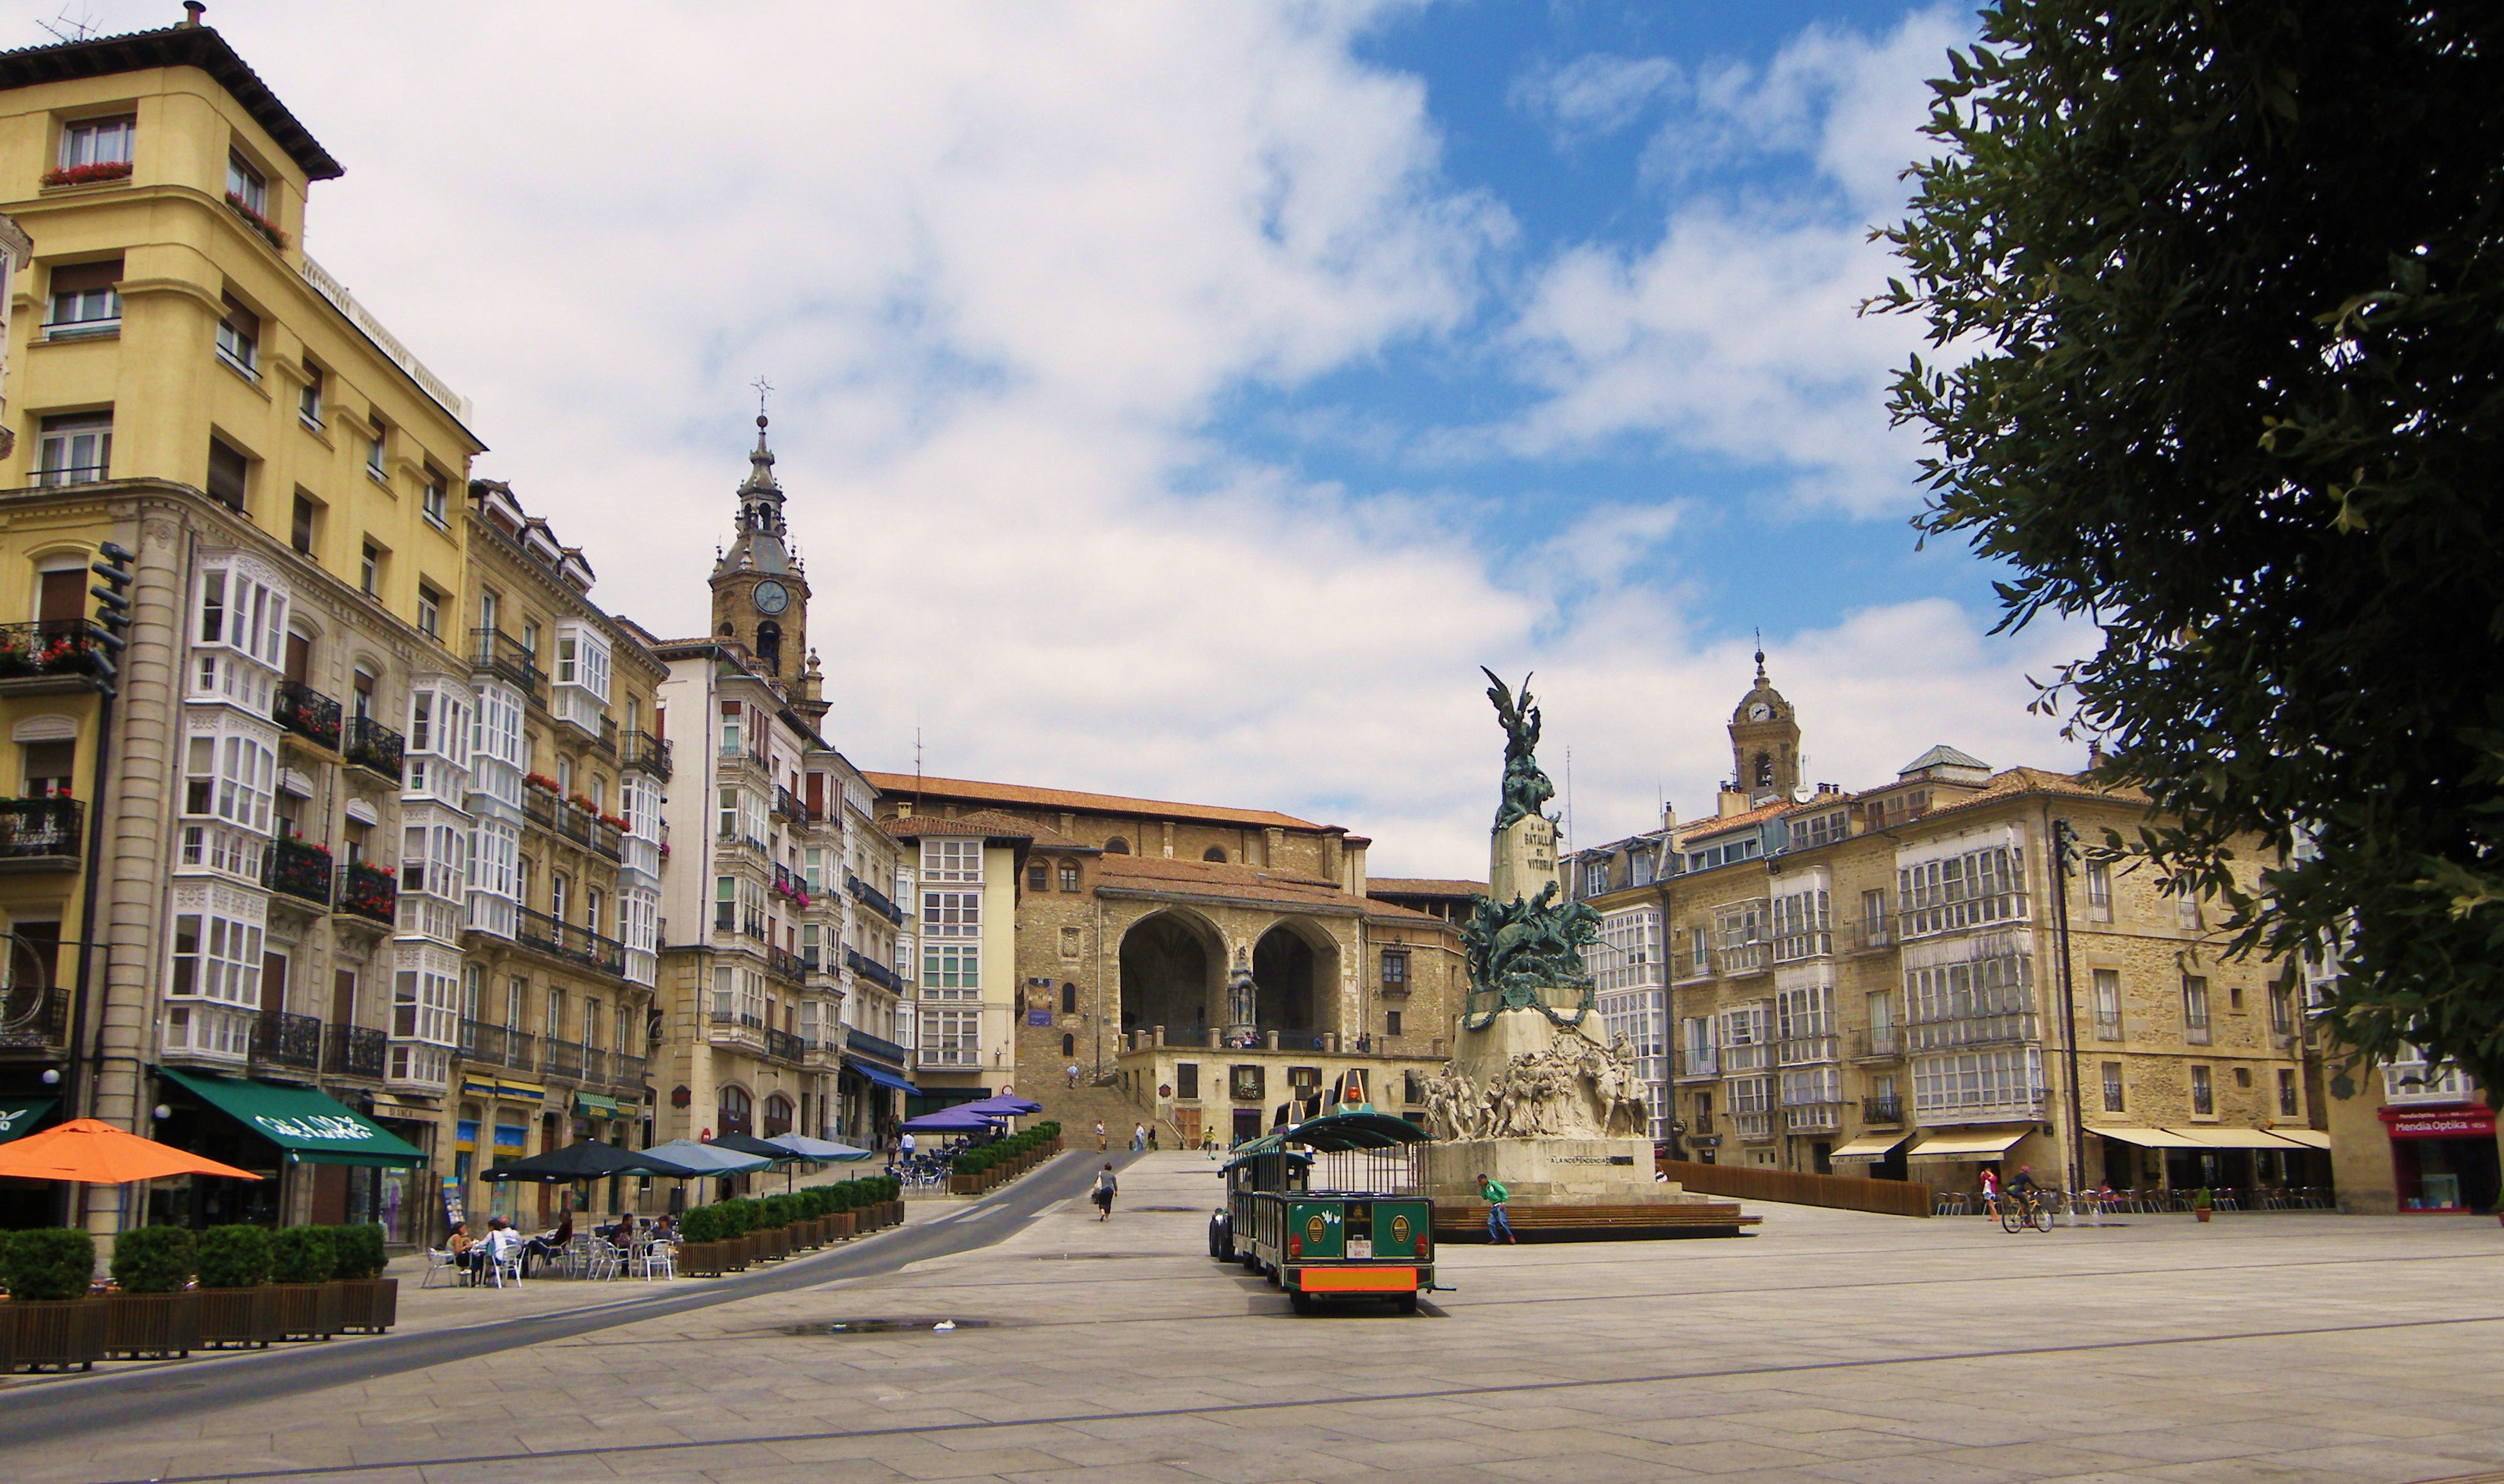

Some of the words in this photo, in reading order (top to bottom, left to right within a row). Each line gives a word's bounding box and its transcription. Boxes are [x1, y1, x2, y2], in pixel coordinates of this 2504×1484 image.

[1537, 823, 1545, 831] LA
[1524, 833, 1553, 846] BATALLA
[1536, 848, 1543, 856] DE
[1527, 859, 1553, 871] VITORIA
